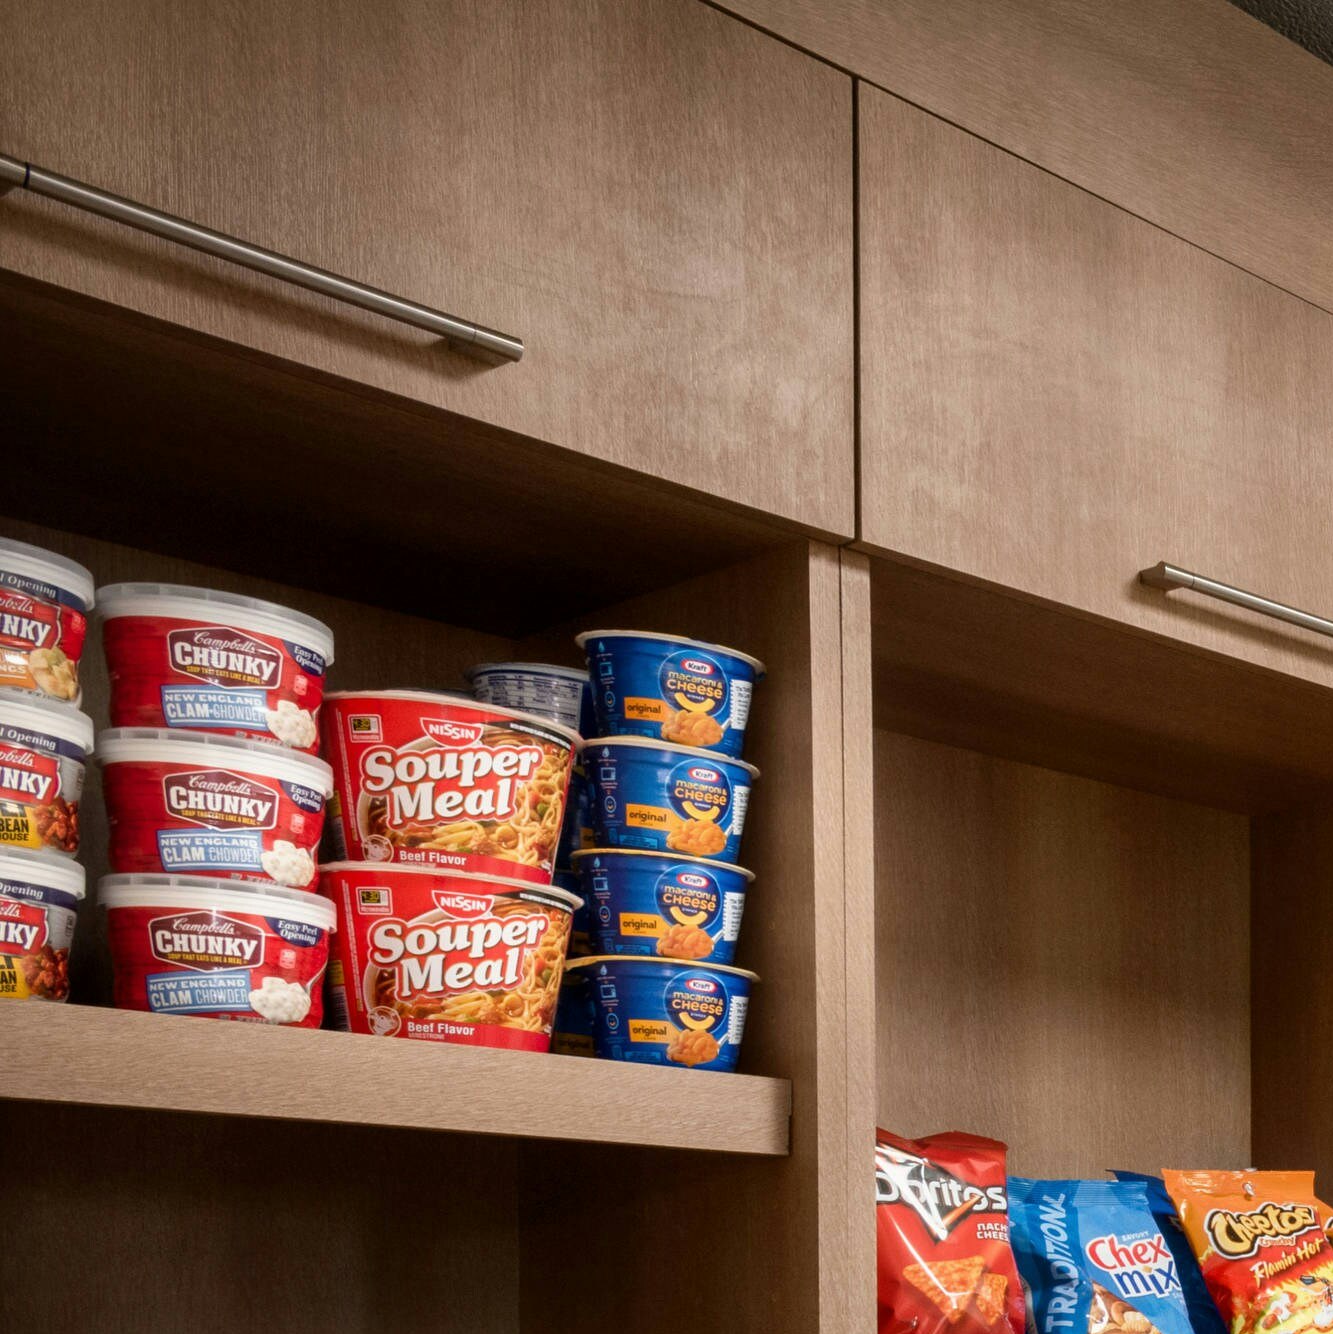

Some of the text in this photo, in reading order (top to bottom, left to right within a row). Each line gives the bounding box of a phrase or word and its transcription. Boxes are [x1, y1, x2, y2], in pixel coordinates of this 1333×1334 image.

[174, 642, 277, 681] CHUNKY
[200, 695, 262, 706] ENGLAND
[167, 703, 209, 718] CLAM
[627, 704, 661, 714] original
[429, 724, 475, 739] NISSIN
[365, 748, 539, 791] Souper
[169, 786, 272, 821] CHUNKY
[392, 779, 511, 825] Meal
[629, 811, 667, 823] original
[161, 838, 258, 848] NEW ENGLAND
[163, 847, 205, 862] CLAM
[441, 896, 486, 911] NISSIN
[623, 921, 657, 929] original
[155, 930, 258, 960] CHUNKY
[374, 918, 546, 964] Souper
[401, 948, 520, 997] Meal
[150, 980, 246, 992] NEW ENGLAND
[151, 991, 192, 1007] CLAM
[408, 1022, 475, 1036] Beef Flavor
[632, 1026, 667, 1036] original
[1211, 1205, 1315, 1254] Cheetos
[1088, 1234, 1171, 1271] Chex
[1297, 1239, 1324, 1260] Hot
